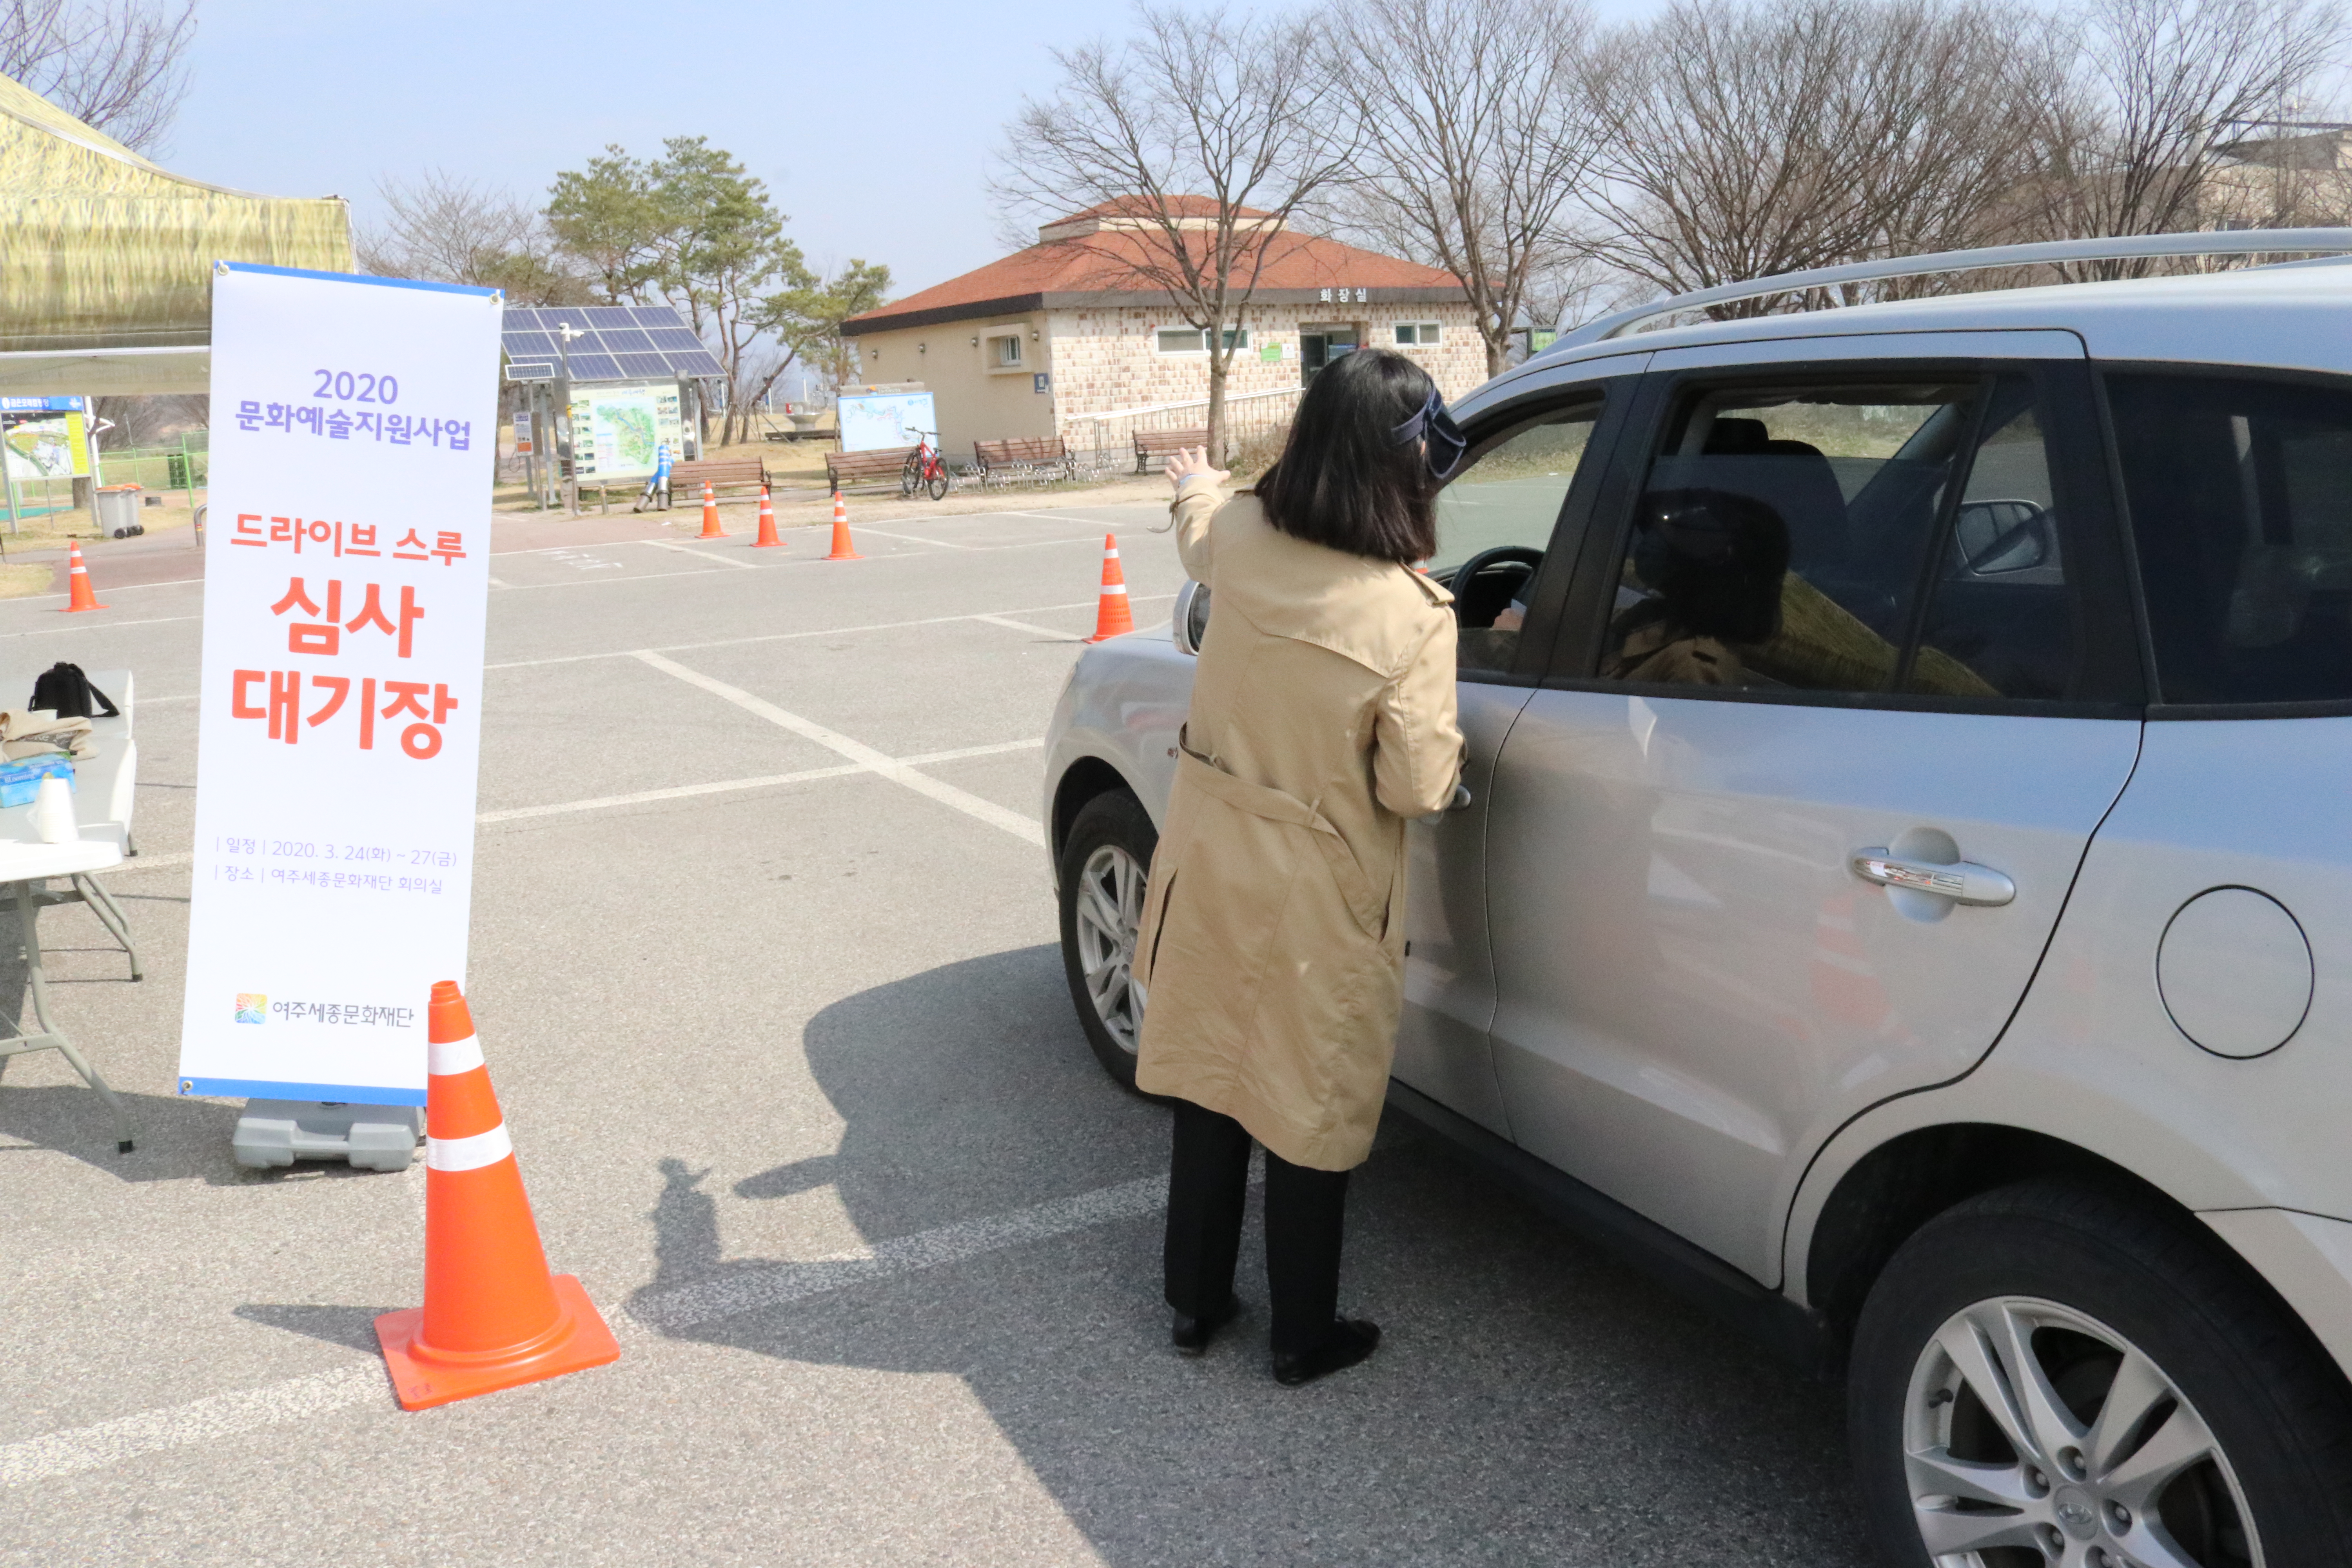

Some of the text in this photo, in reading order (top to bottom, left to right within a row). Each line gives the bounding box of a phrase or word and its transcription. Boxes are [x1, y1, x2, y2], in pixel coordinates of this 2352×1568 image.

[1320, 288, 1367, 303] 화장실
[313, 369, 398, 404] 2020
[235, 400, 470, 451] 문화예술지원사업
[230, 514, 466, 566] 드라이브 스루
[270, 577, 425, 658] 심사
[232, 669, 458, 760] 대기장
[226, 837, 255, 855] 일정
[272, 840, 319, 858] 2020.
[325, 844, 338, 859] 3.
[345, 846, 391, 862] 24(화)
[411, 849, 457, 867] 27(금)
[225, 866, 442, 894] 장소 여주세종문화재단 회의실
[272, 1002, 414, 1027] 여주세종문화재단
